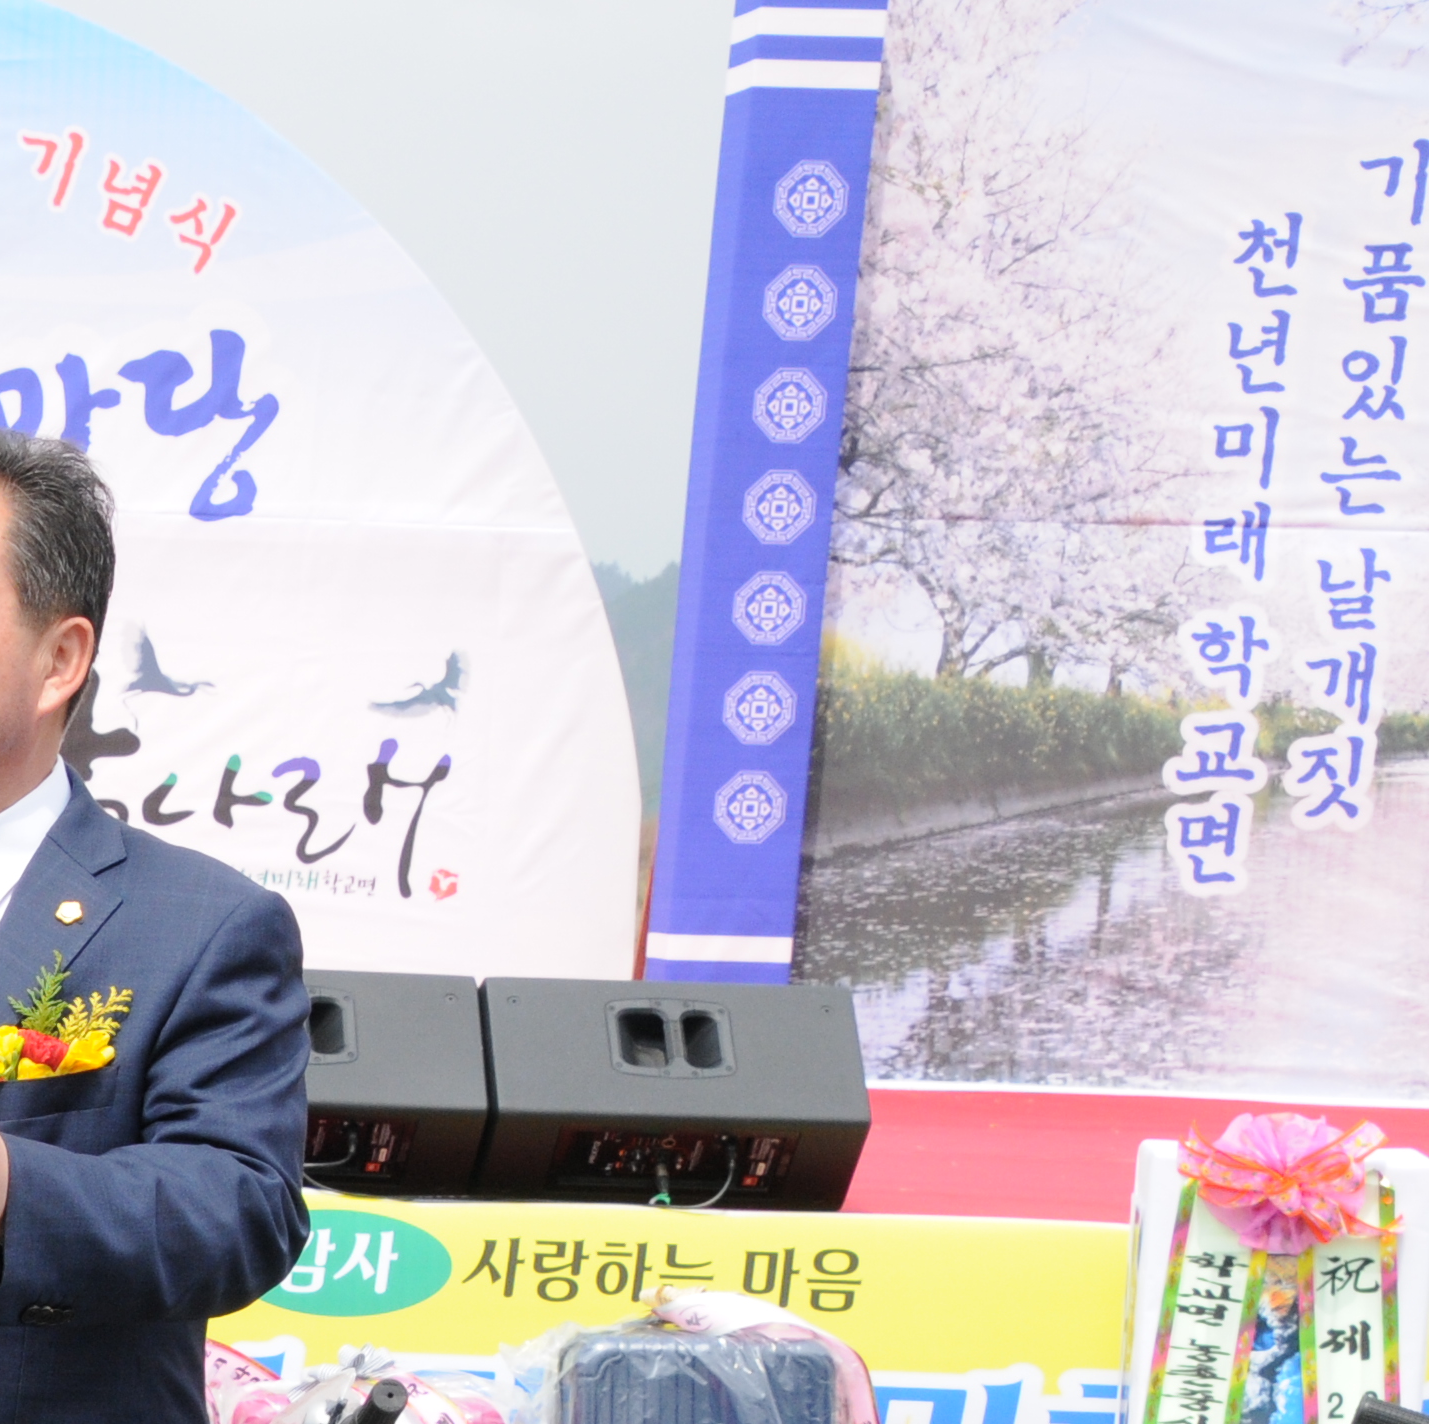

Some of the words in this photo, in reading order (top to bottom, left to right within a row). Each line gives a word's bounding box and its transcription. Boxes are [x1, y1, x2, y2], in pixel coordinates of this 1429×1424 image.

[22, 131, 241, 277] 기념식
[1319, 139, 1429, 516] 기품있는
[1203, 211, 1302, 584] 천년미래
[1176, 616, 1268, 885] 학교면
[1298, 548, 1391, 819] 날개짓
[462, 1236, 715, 1304] 사랑하는
[743, 1246, 863, 1313] 마음
[1316, 1256, 1381, 1296] 祝
